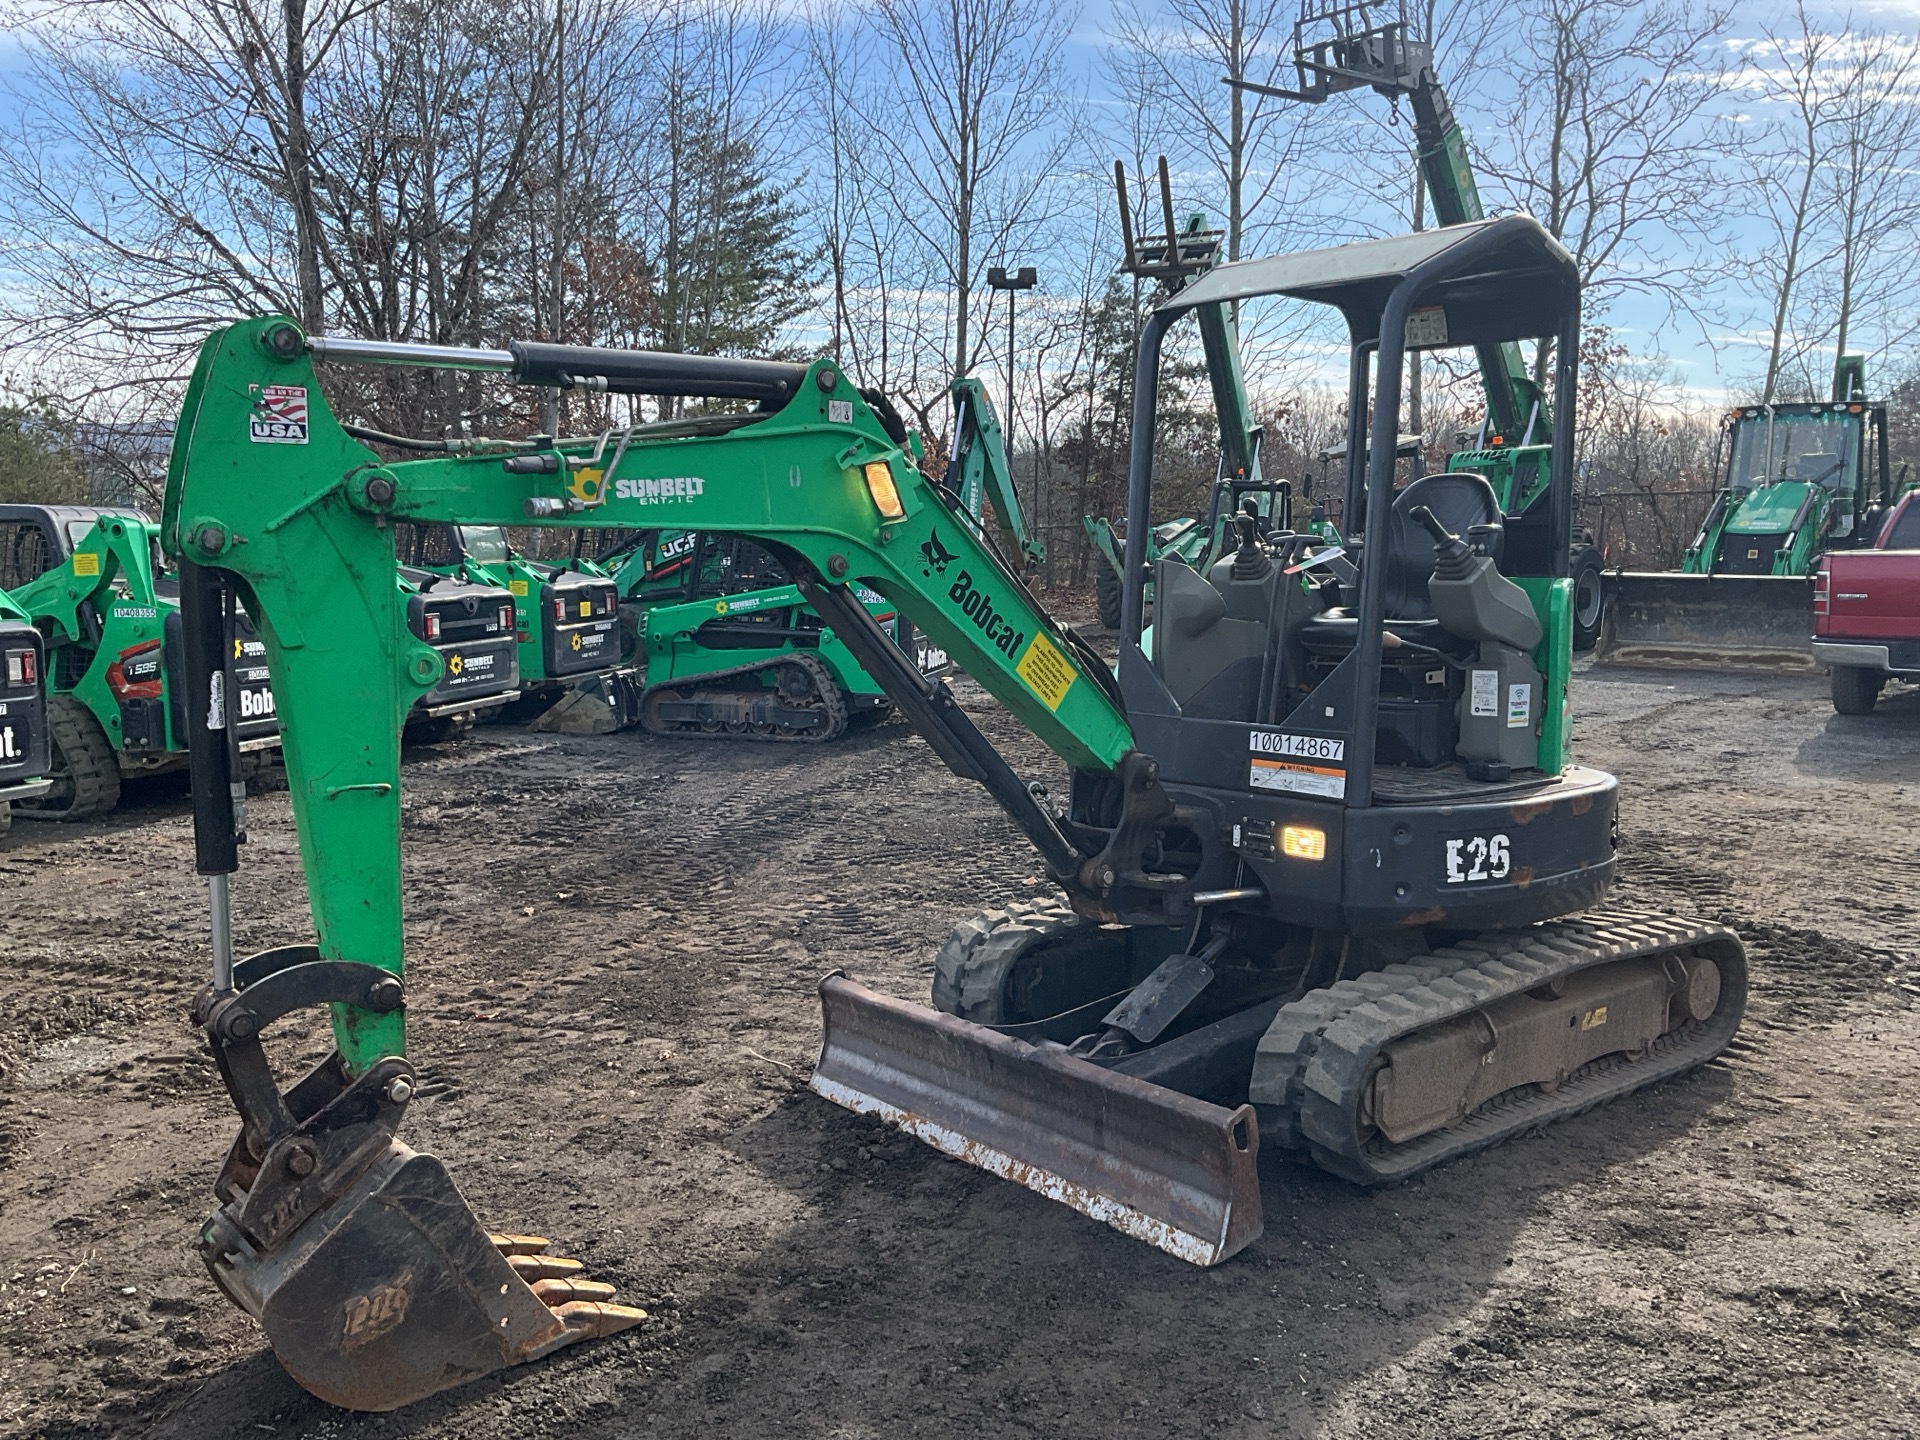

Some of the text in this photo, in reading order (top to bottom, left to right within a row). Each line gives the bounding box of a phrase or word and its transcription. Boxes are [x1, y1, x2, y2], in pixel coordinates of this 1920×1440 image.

[254, 424, 304, 438] USA
[615, 477, 705, 498] SUNBELT
[729, 598, 760, 610] SUNBELT
[114, 609, 156, 617] 10408355
[948, 569, 1025, 661] Bobcat
[128, 661, 157, 676] T595
[464, 655, 494, 669] SUNBELT
[1252, 733, 1343, 759] 10014867
[1446, 834, 1511, 883] E26
